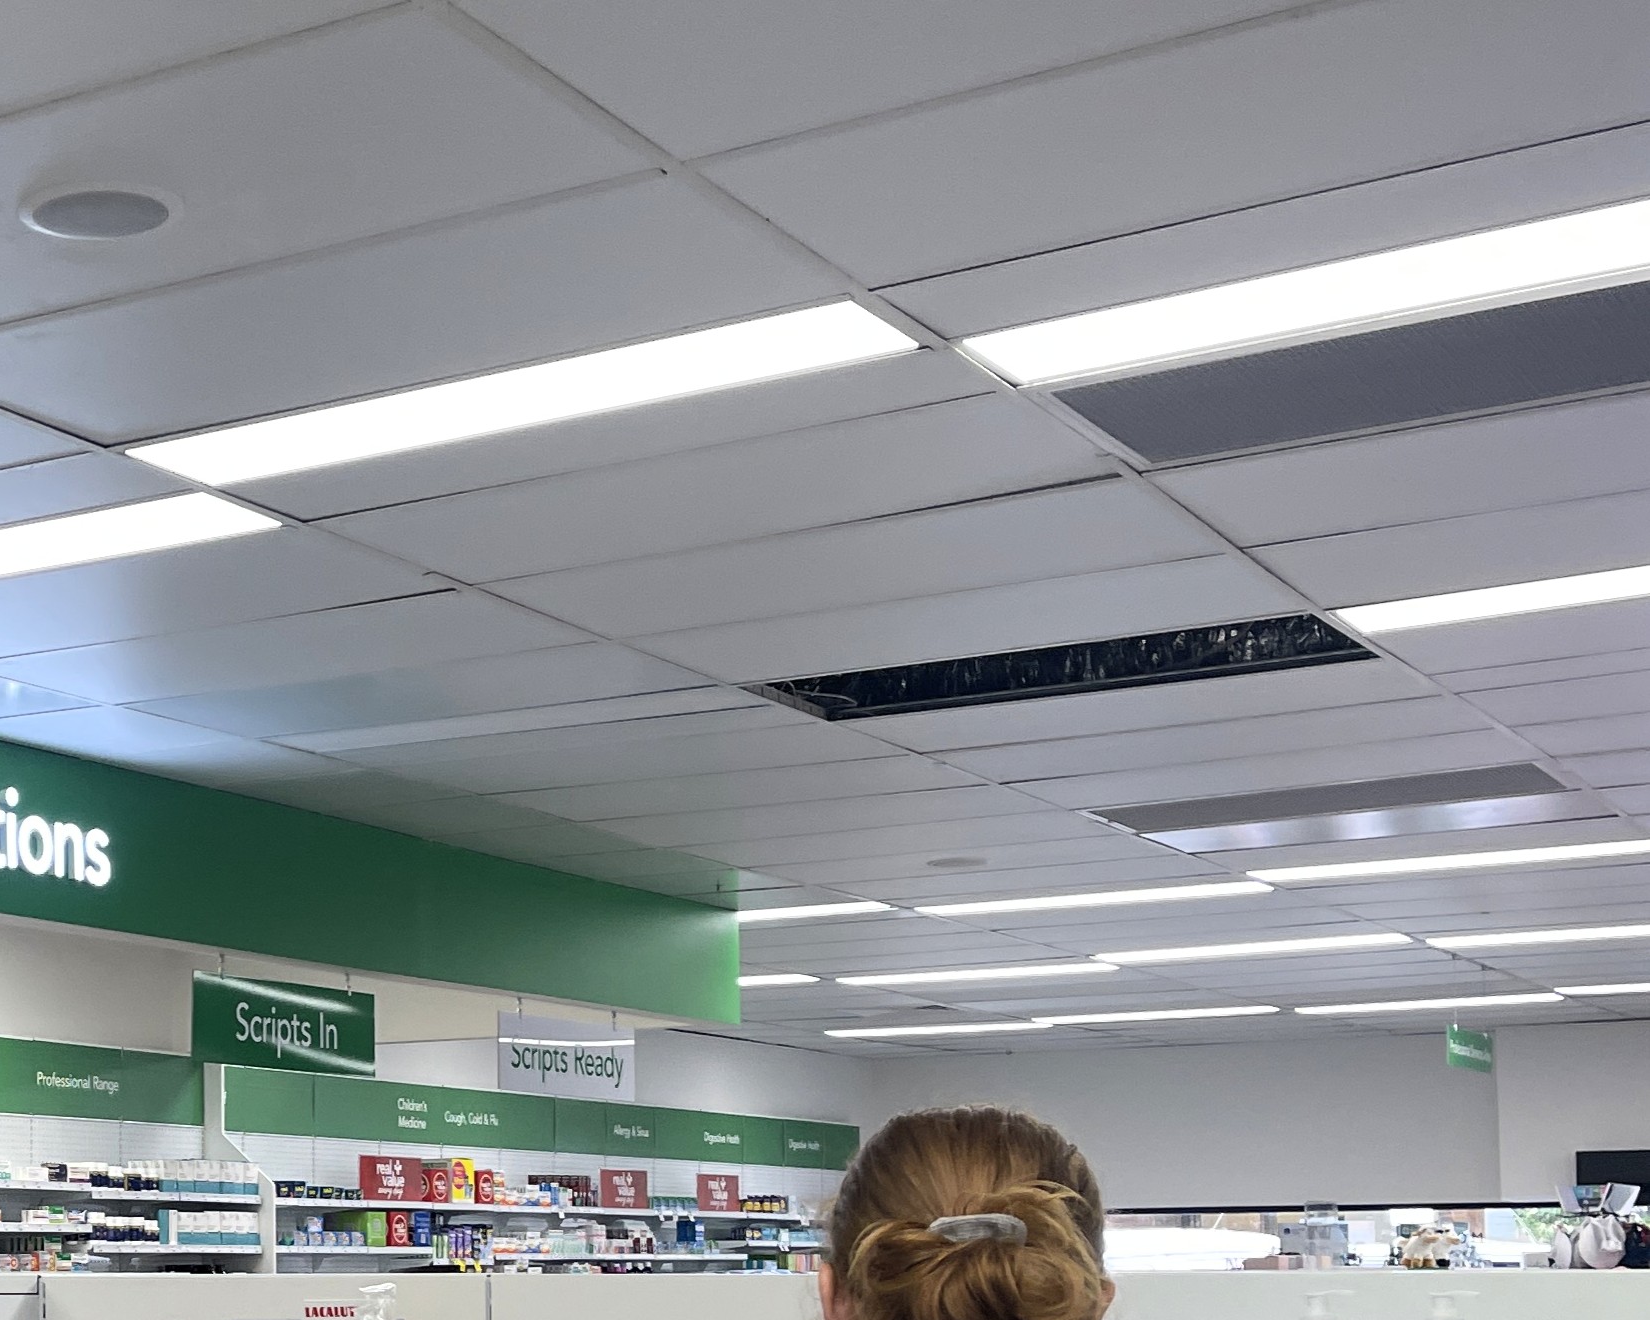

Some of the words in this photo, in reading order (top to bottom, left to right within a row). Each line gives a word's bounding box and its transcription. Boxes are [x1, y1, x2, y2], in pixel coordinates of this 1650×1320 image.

[235, 1001, 312, 1055] Scripts
[318, 1011, 338, 1050] In
[510, 1042, 568, 1083] Scripts
[574, 1044, 624, 1088] Ready
[36, 1072, 88, 1091] Professional
[90, 1075, 119, 1094] Range
[398, 1098, 428, 1112] Children's
[399, 1116, 427, 1130] Medicine
[445, 1111, 467, 1126] Cough,
[469, 1112, 483, 1125] Cold
[376, 1159, 392, 1175] real
[382, 1175, 405, 1187] value
